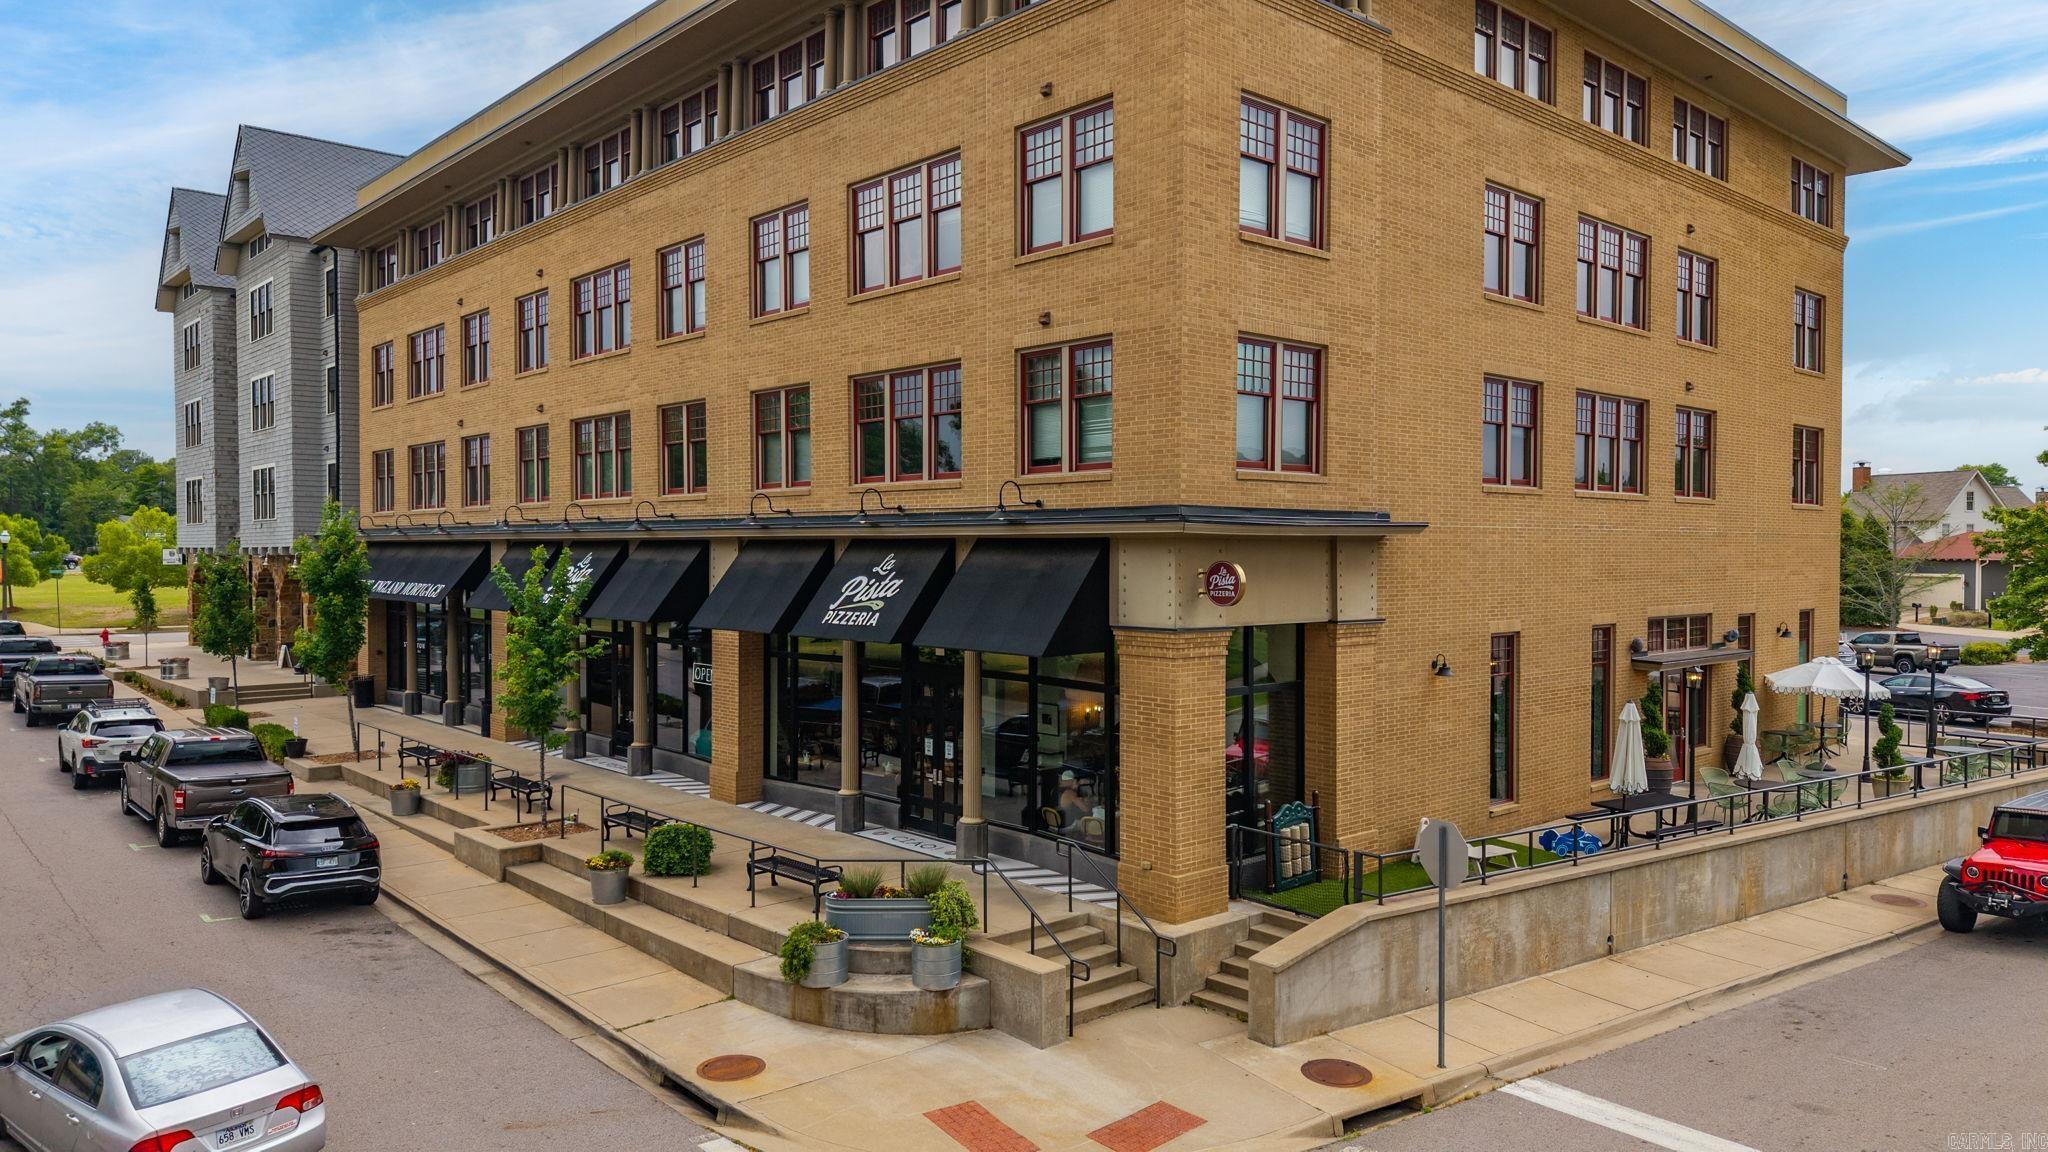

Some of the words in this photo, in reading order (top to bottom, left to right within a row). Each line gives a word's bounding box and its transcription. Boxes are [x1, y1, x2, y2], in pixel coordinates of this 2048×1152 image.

[873, 553, 896, 575] La
[1218, 566, 1227, 576] La
[1209, 573, 1236, 590] Pista
[829, 571, 903, 610] Pista
[821, 610, 880, 627] PIZZERIA
[695, 667, 712, 682] OPE
[218, 1131, 235, 1145] 658
[239, 1125, 255, 1137] VMS
